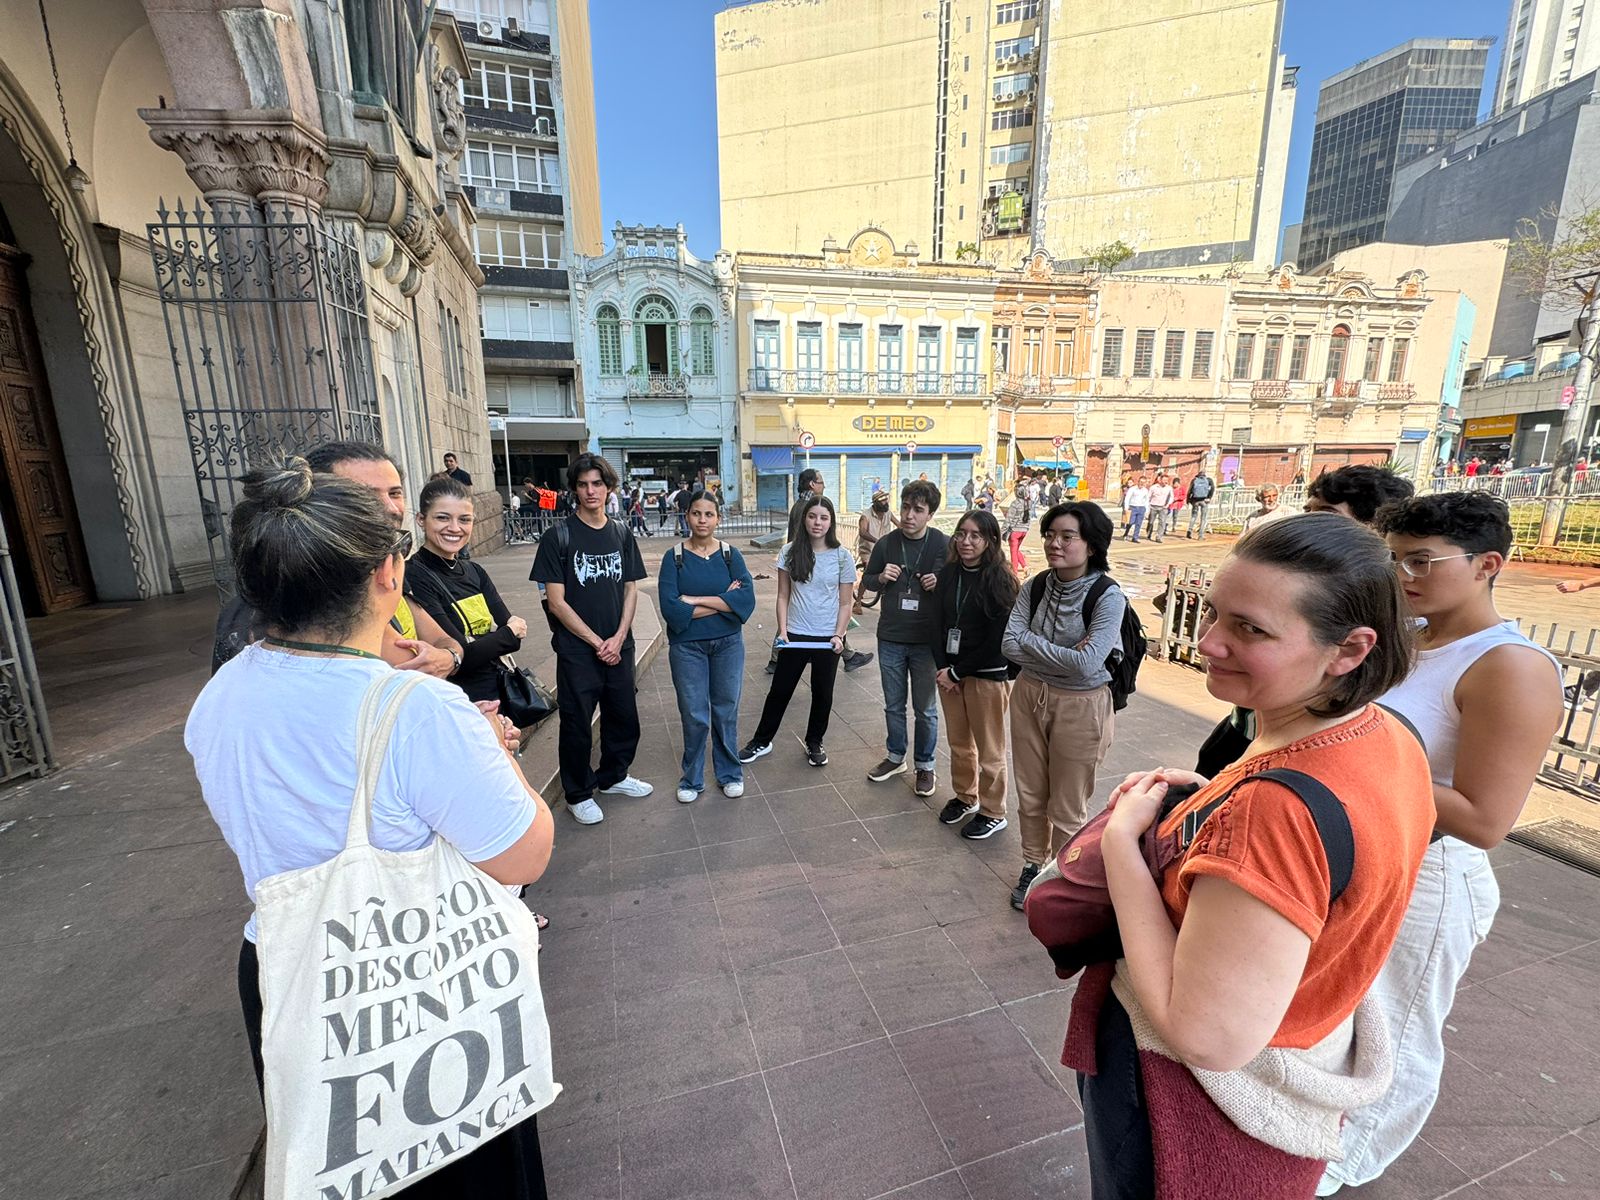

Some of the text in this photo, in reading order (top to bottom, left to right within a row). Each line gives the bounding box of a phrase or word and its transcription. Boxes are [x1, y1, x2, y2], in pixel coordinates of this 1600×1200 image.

[321, 911, 512, 1003] DESCOBRI
[322, 878, 496, 961] NÃO FOI
[321, 947, 520, 1062] MENTO
[315, 994, 532, 1176] FOI
[318, 1081, 536, 1200] MATANÇA
